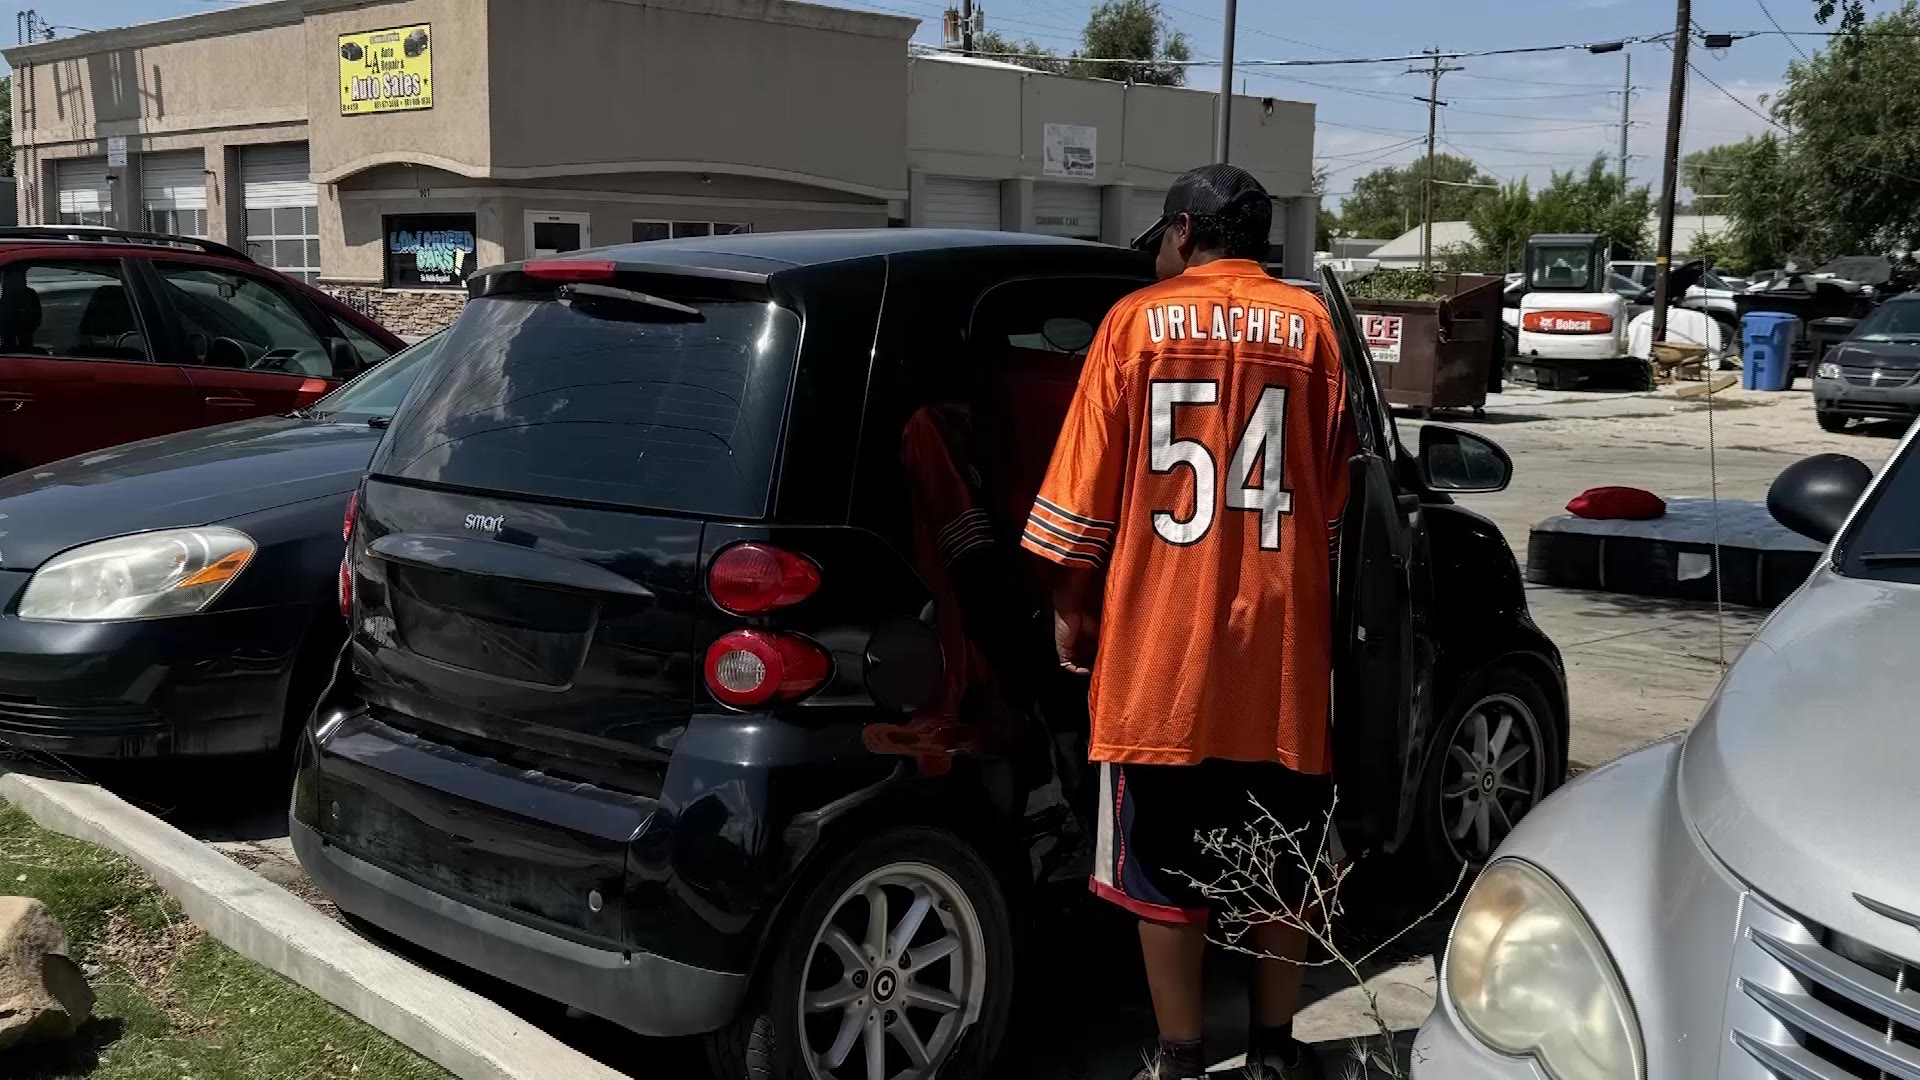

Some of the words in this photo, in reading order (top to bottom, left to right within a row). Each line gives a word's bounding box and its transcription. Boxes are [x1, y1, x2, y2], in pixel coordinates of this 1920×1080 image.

[364, 45, 380, 74] LA
[351, 75, 380, 101] Auto
[382, 70, 420, 98] Sales
[390, 231, 423, 254] LOW
[423, 230, 474, 254] PRICED
[1146, 303, 1306, 350] URLACHER
[1357, 316, 1400, 339] CE
[1555, 319, 1592, 331] Bobcat
[1149, 379, 1294, 552] 54
[464, 513, 505, 533] smart
